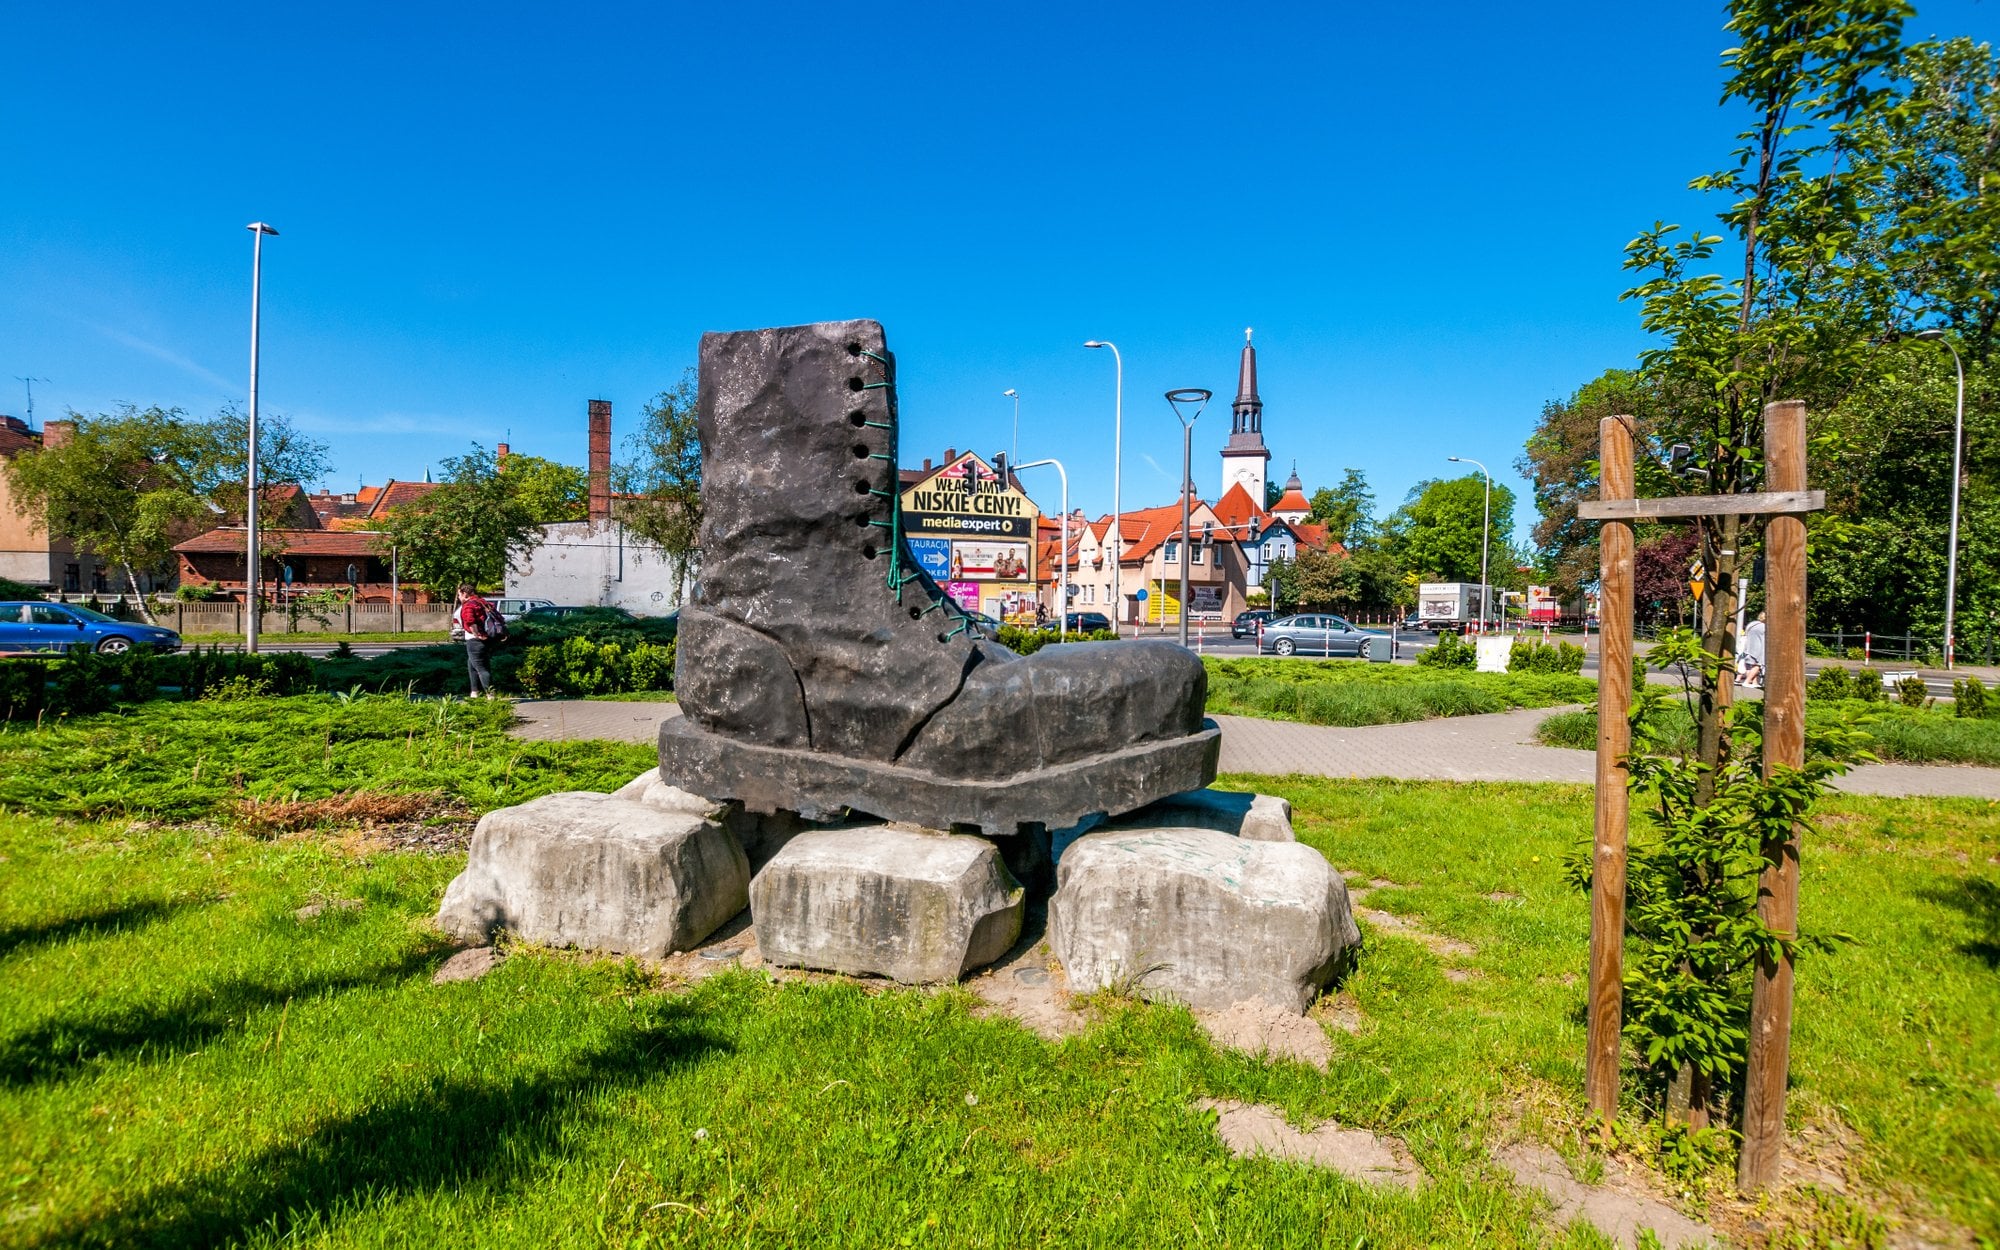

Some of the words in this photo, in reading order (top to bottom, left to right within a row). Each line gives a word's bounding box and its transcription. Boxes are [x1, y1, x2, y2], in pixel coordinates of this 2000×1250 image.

[913, 491, 970, 513] NISKIE
[973, 494, 1021, 516] CENY!
[922, 516, 1001, 531] mediaexpert
